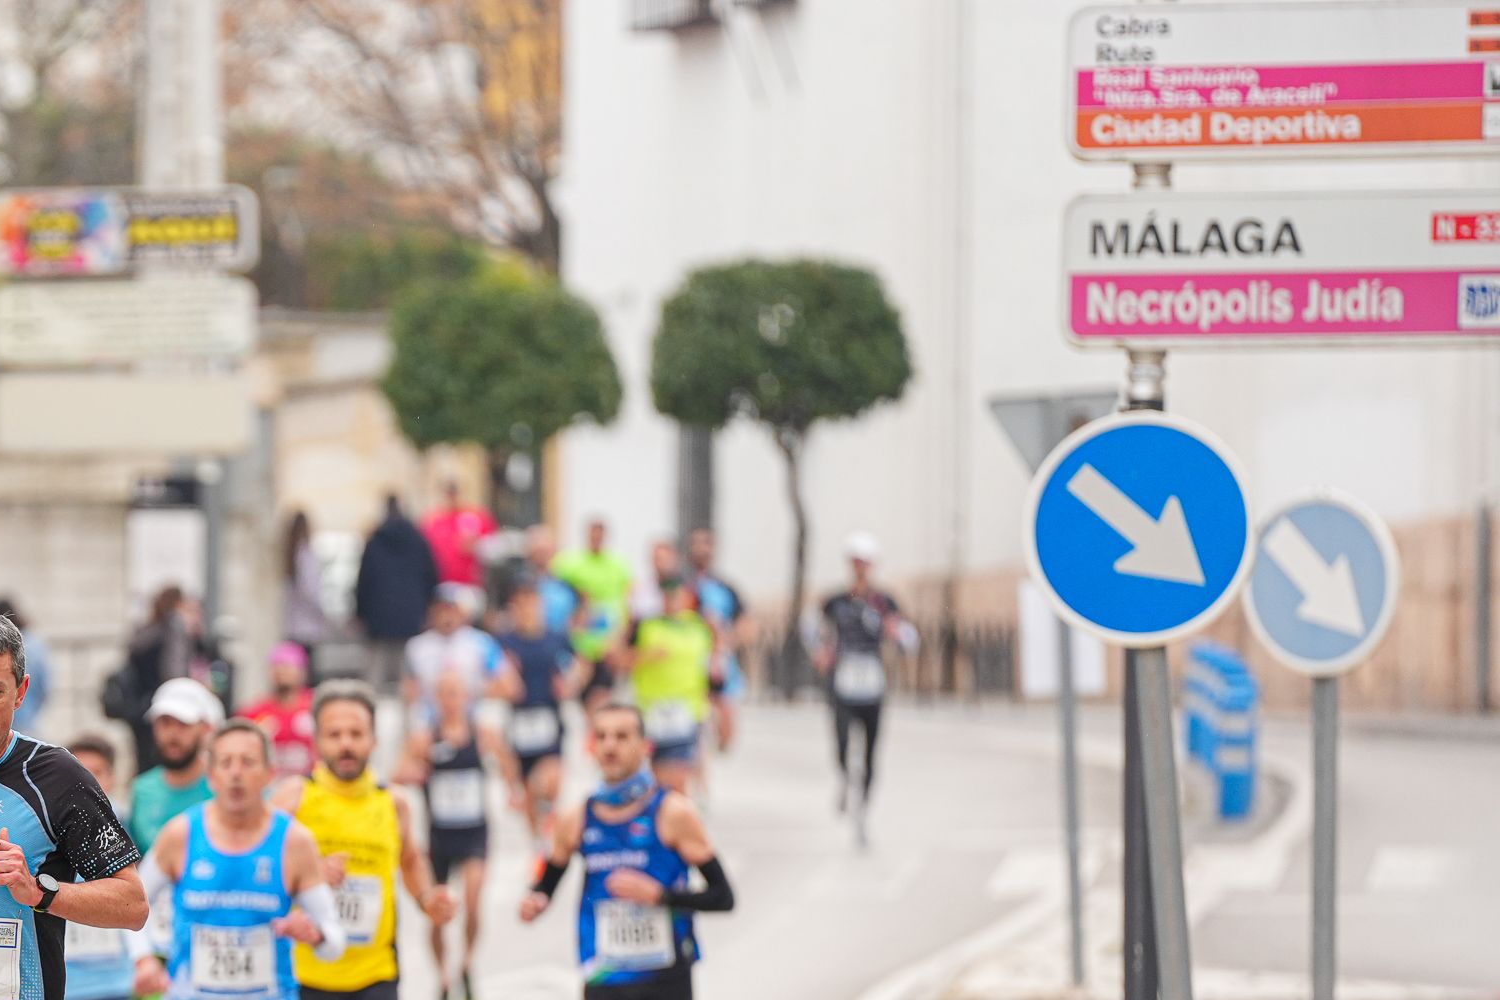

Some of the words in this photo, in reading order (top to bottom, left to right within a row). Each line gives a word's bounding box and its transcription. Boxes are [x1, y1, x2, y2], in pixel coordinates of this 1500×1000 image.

[1096, 16, 1170, 37] Cabra
[1150, 65, 1259, 87] Santuario
[1211, 87, 1242, 107] de
[1091, 112, 1201, 143] Ciudad
[1209, 110, 1362, 145] Deportiva
[1090, 211, 1303, 257] MÁLAGA
[1086, 281, 1293, 330] Necrópolis
[1302, 278, 1404, 322] Judía
